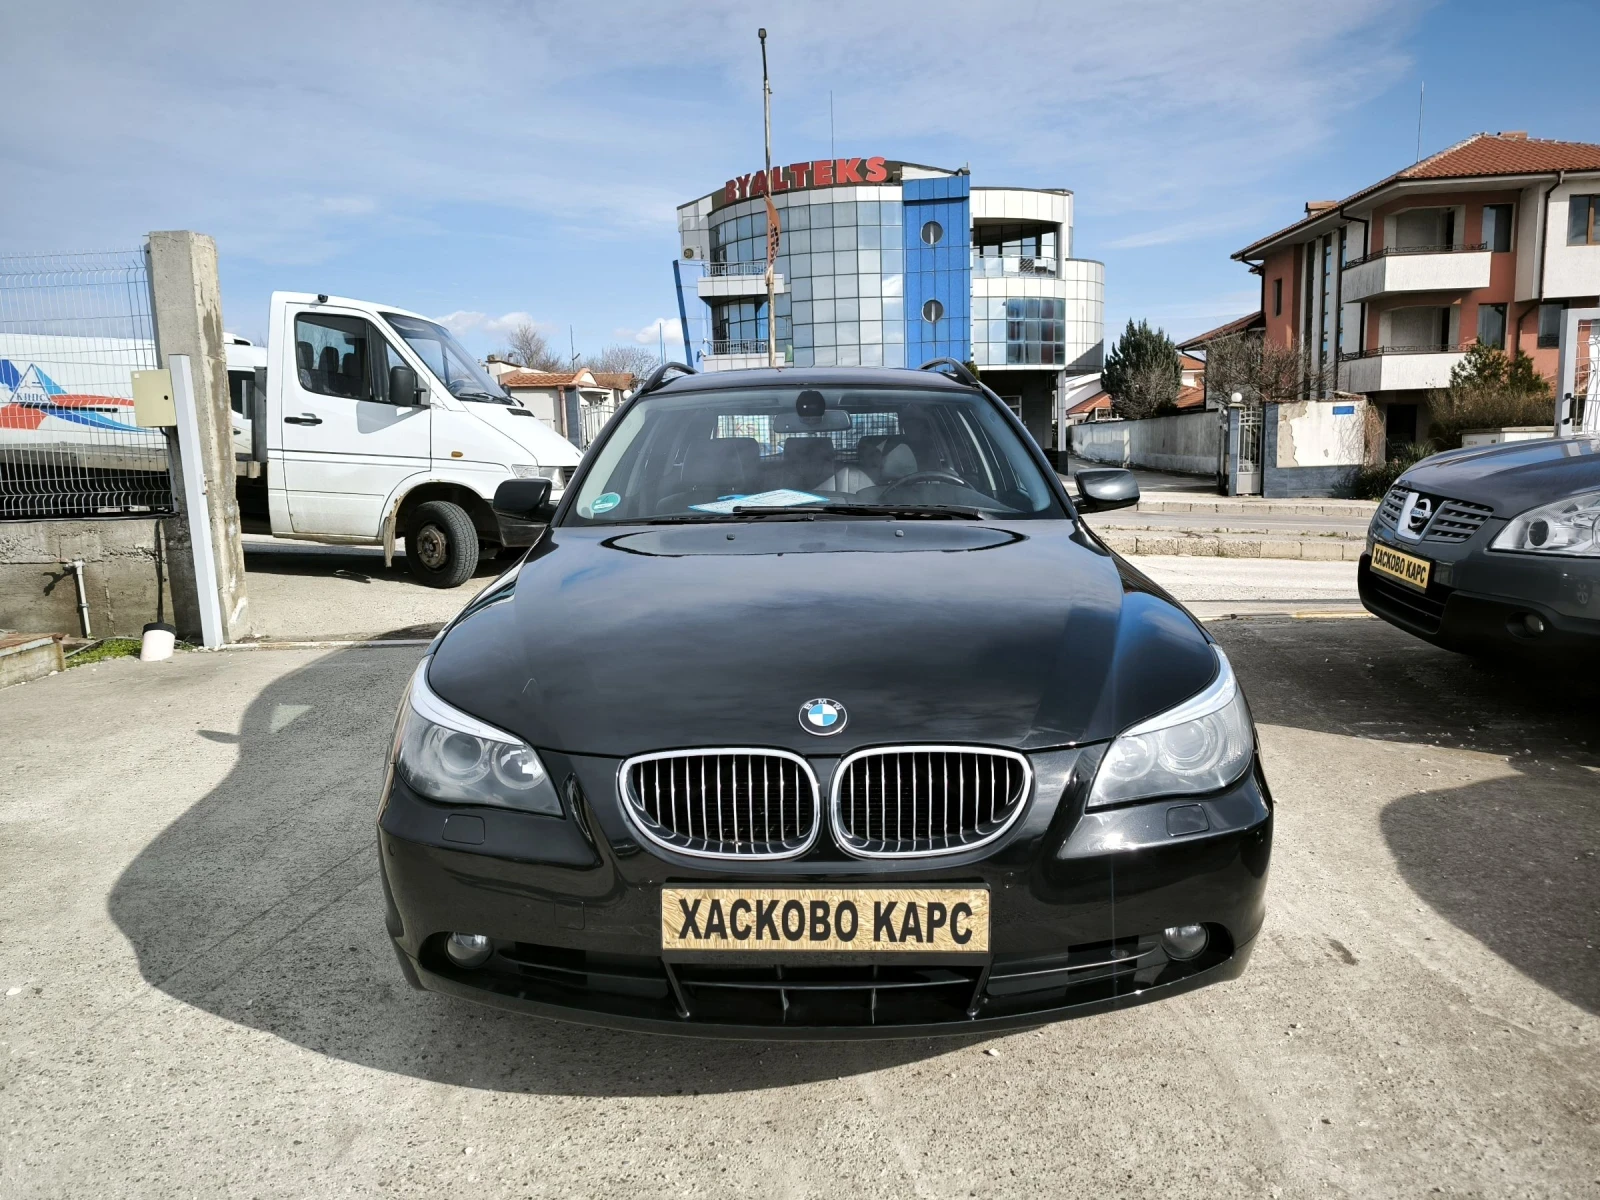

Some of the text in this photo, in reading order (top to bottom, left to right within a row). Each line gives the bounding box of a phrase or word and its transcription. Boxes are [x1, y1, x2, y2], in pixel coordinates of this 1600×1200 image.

[725, 156, 888, 204] BYALTEKS
[1373, 548, 1427, 584] ХАСКОВО КАРС
[803, 699, 843, 710] BMW
[678, 898, 973, 945] ХАСКОВО КАРС
